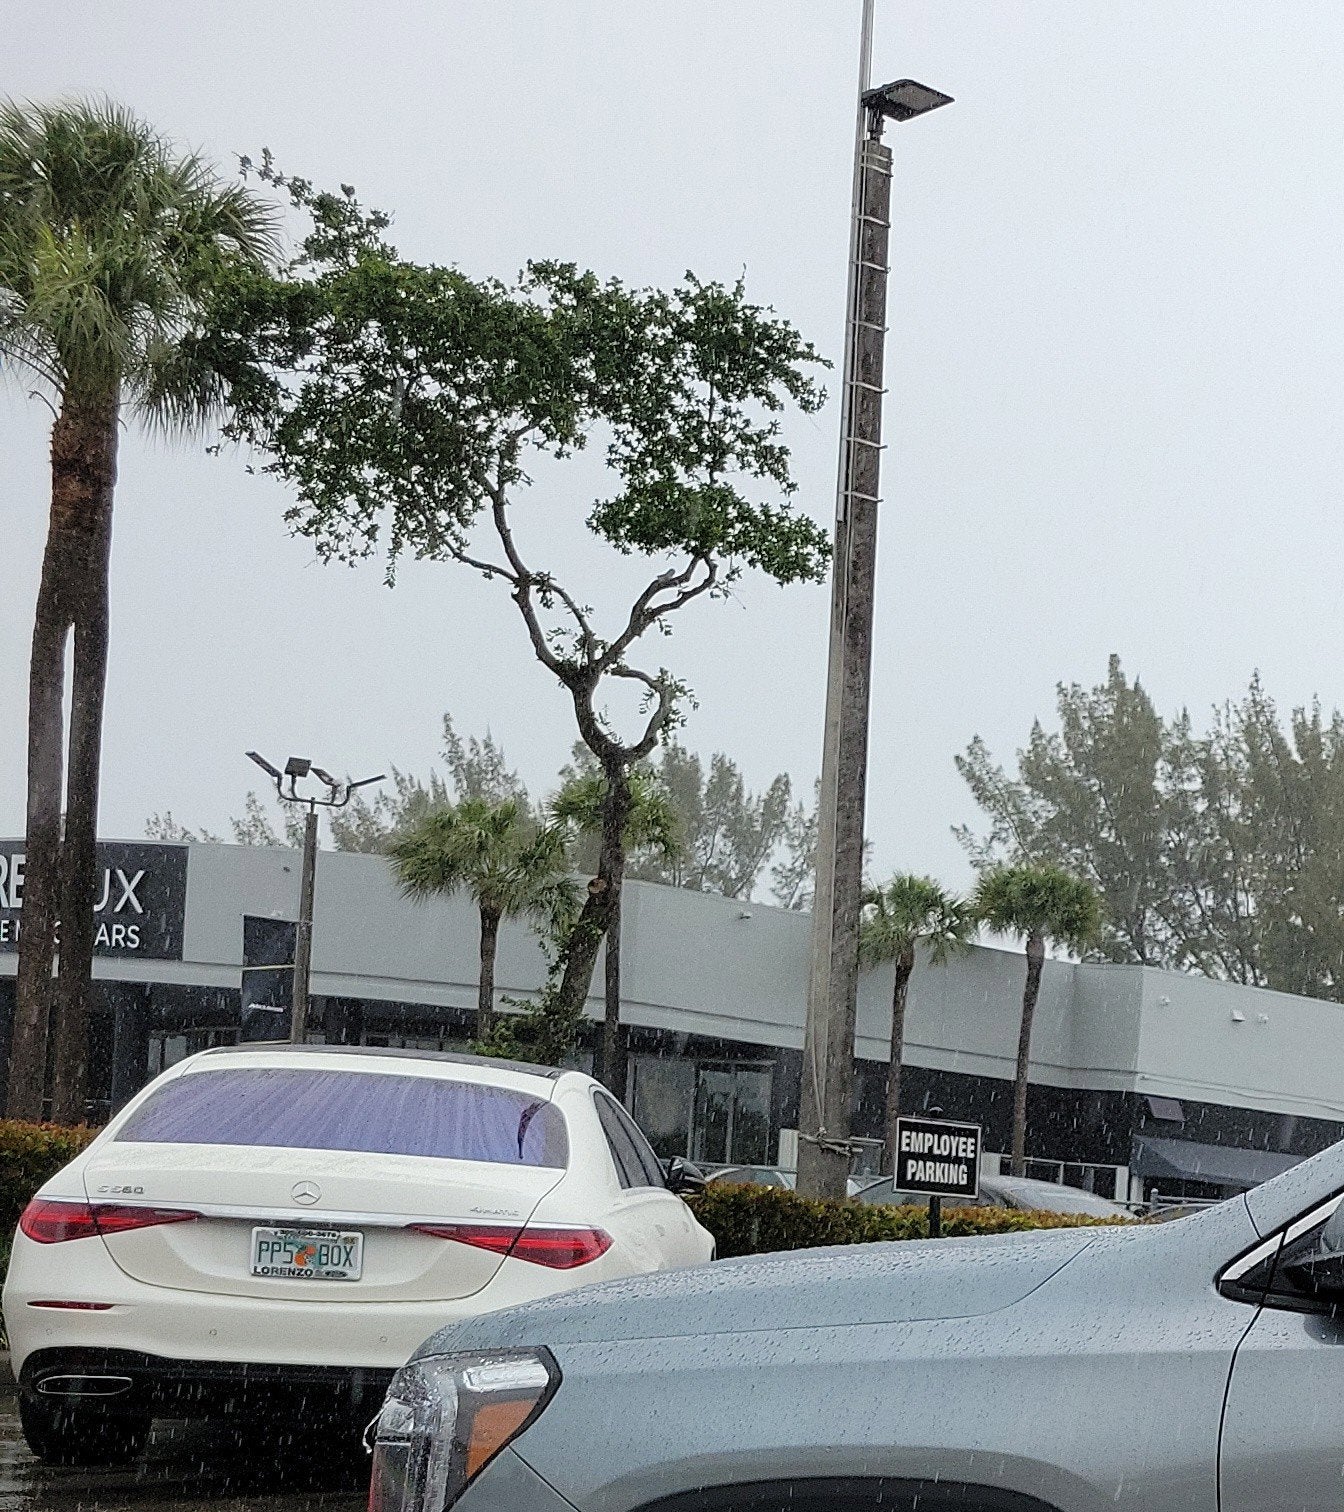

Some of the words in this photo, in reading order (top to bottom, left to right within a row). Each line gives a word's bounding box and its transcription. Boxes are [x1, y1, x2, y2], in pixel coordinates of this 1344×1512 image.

[94, 922, 140, 949] ARS
[901, 1131, 975, 1159] EMPLOYEE
[906, 1159, 968, 1185] PARKING
[253, 1265, 314, 1277] LORENZO
